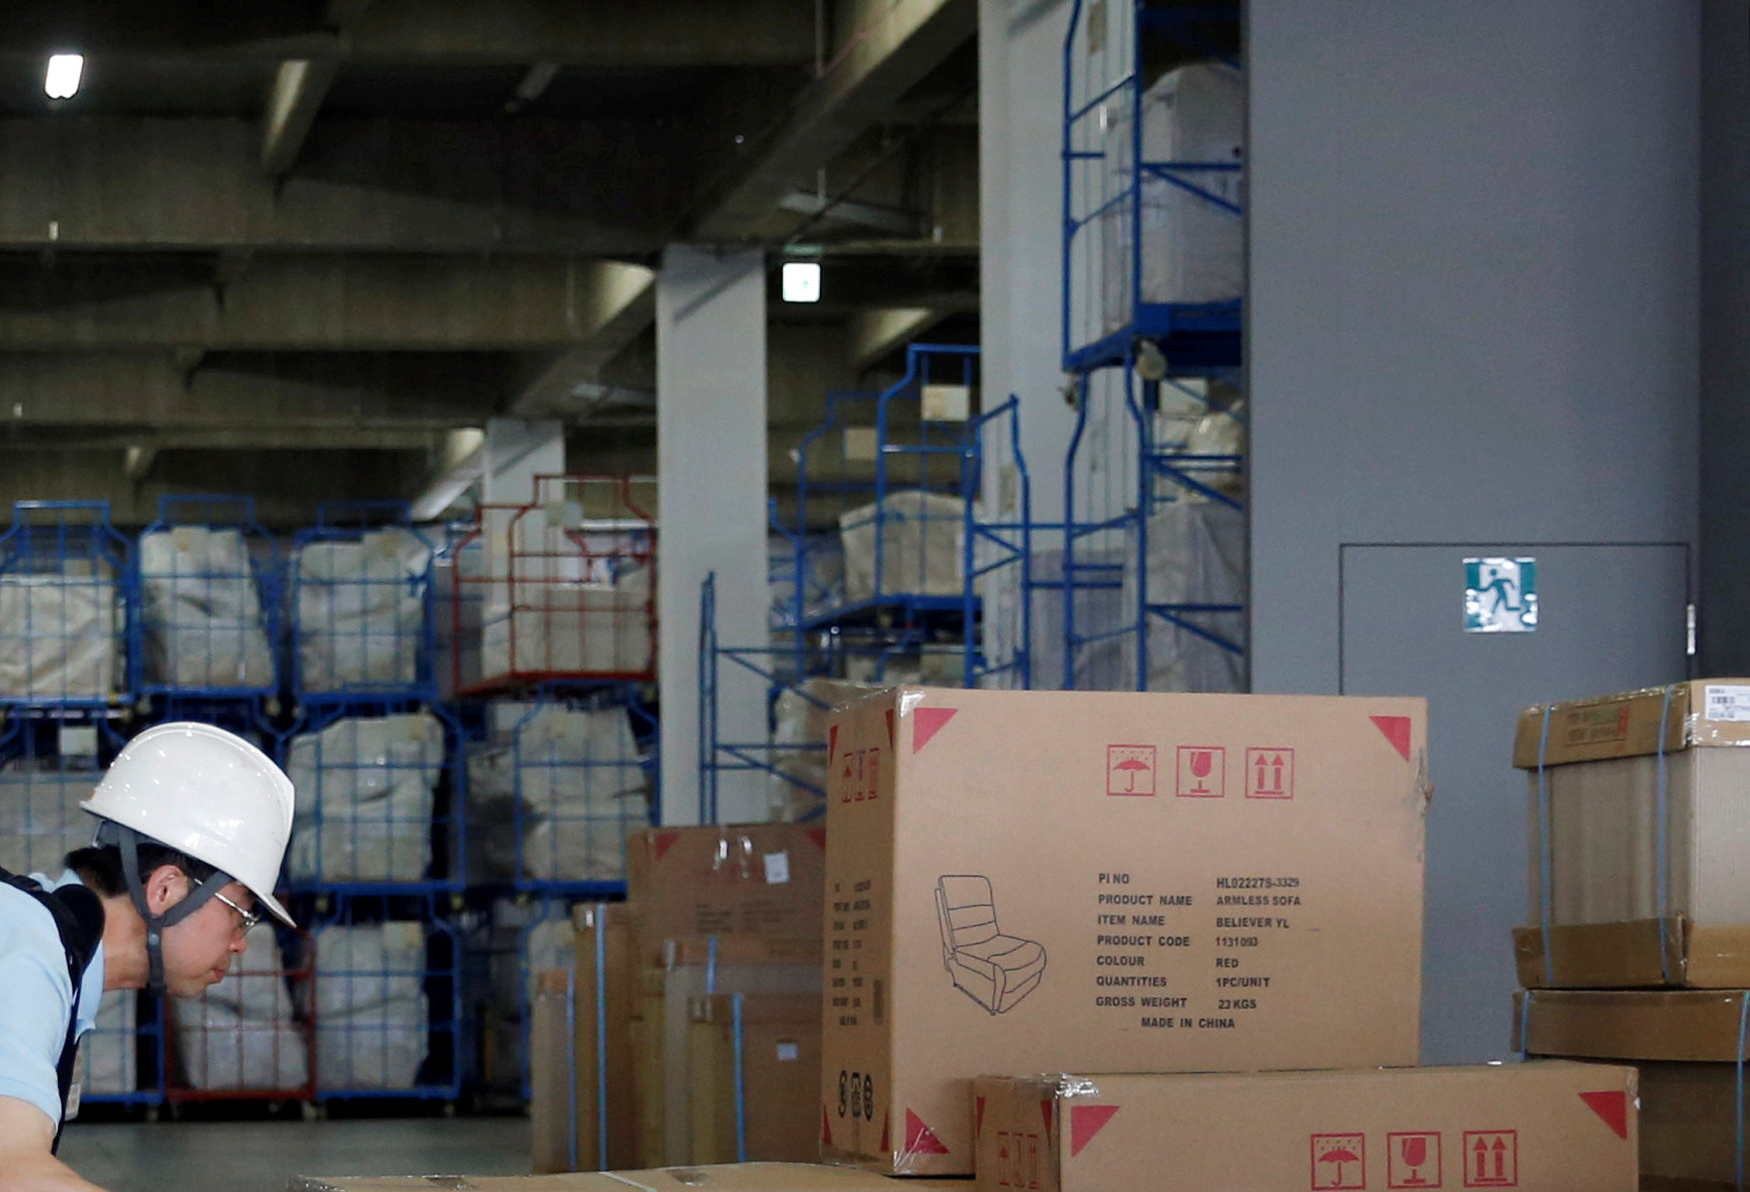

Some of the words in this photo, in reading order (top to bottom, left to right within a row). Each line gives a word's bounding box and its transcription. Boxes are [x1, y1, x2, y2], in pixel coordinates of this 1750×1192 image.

[1098, 873, 1110, 884] PI
[1112, 873, 1130, 884] NO
[1097, 894, 1153, 905] PRODUCT
[1159, 895, 1192, 906] NAME
[1216, 896, 1269, 906] ARMLESS
[1272, 896, 1301, 906] SOFA
[1097, 915, 1126, 926] ITEM
[1132, 915, 1165, 926] NAME
[1216, 917, 1272, 928] BELIEVER
[1275, 918, 1290, 929] YL
[1097, 935, 1152, 946] PRODUCT
[1158, 936, 1190, 947] CODE
[1096, 956, 1145, 967] COLOUR
[1215, 958, 1239, 968] RED
[1096, 976, 1167, 987] QUANTITIES
[1215, 977, 1271, 988] 1PC/UNIT
[1095, 996, 1135, 1007] GROSS
[1141, 997, 1188, 1008] WEIGHT
[1218, 1000, 1231, 1010] 23
[1233, 1000, 1257, 1010] KGS
[1141, 1017, 1174, 1028] MADE
[1180, 1018, 1192, 1028] IN
[1198, 1018, 1235, 1028] CHINA
